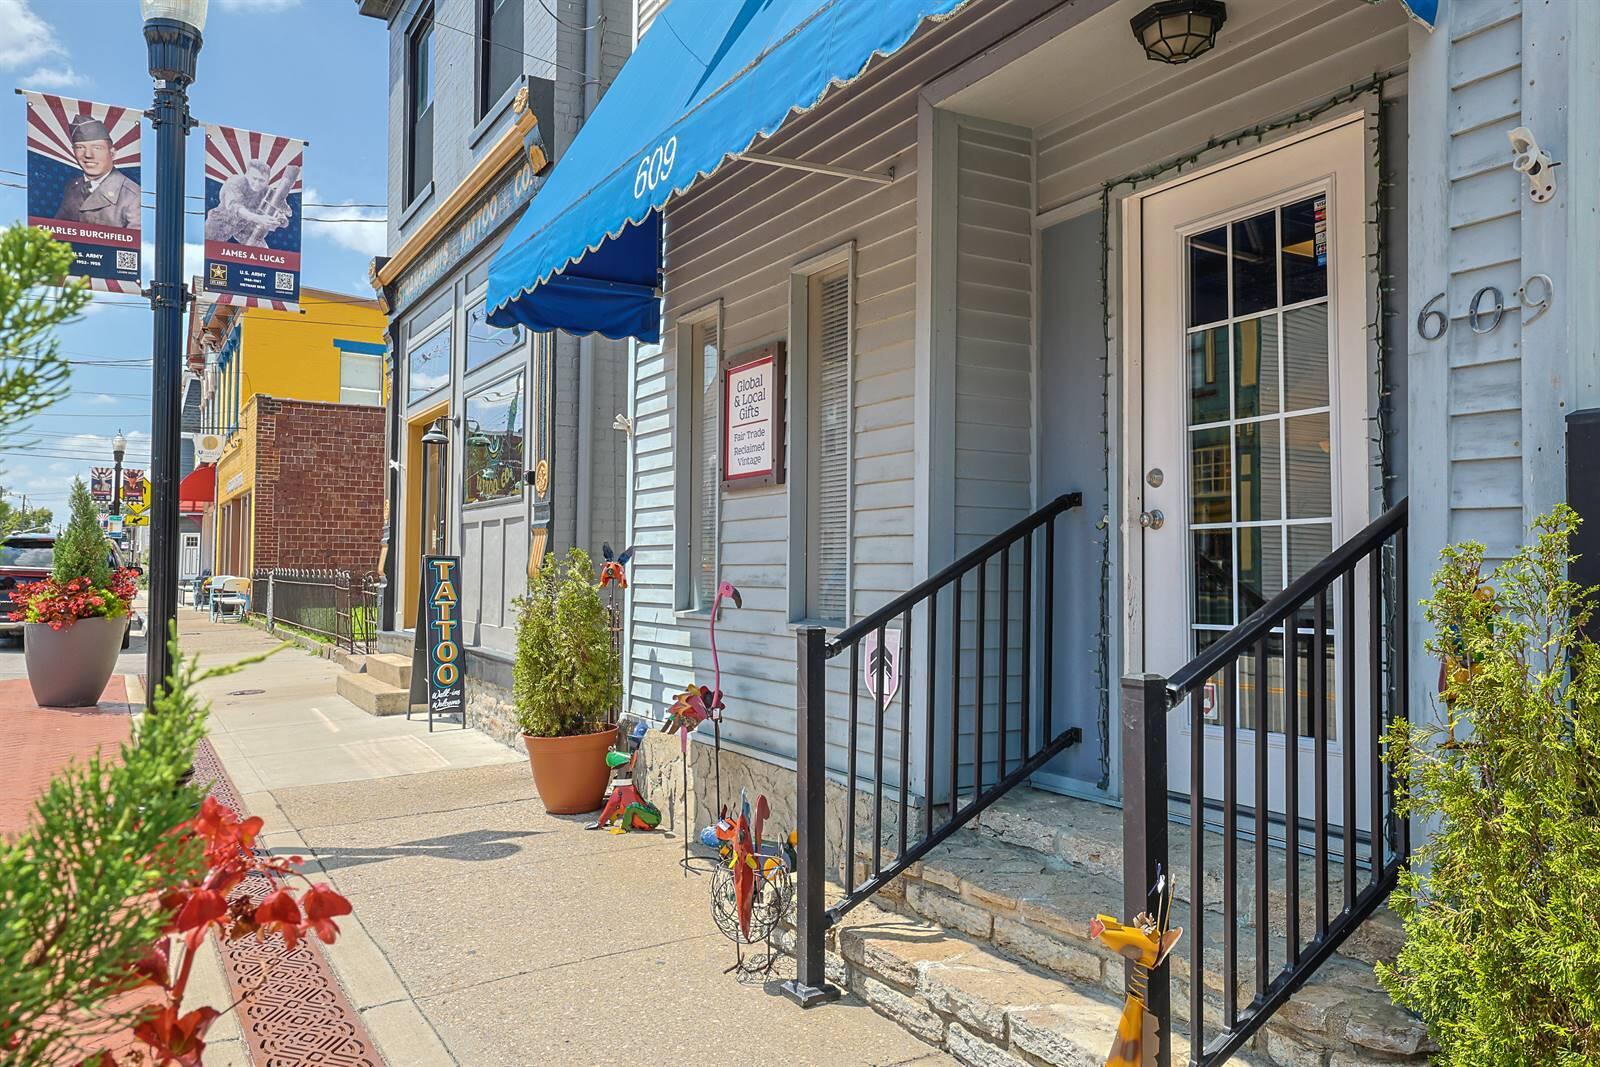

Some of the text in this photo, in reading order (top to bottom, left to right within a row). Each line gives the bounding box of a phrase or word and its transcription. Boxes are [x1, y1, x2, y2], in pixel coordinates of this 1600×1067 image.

[633, 135, 677, 199] 609
[460, 194, 498, 249] TATTOO
[37, 224, 134, 243] CHARLES BURCHFIELD
[85, 252, 104, 260] ARMY
[220, 248, 248, 259] JAMES
[260, 253, 285, 264] LUCAS
[1417, 273, 1553, 341] 609
[737, 374, 763, 392] Global
[734, 388, 765, 408] & Local
[739, 404, 759, 421] Gifts
[734, 428, 765, 442] Fair Trade
[734, 442, 765, 456] Reclaimed
[737, 455, 761, 466] Vintage
[430, 561, 458, 688] TATTOO
